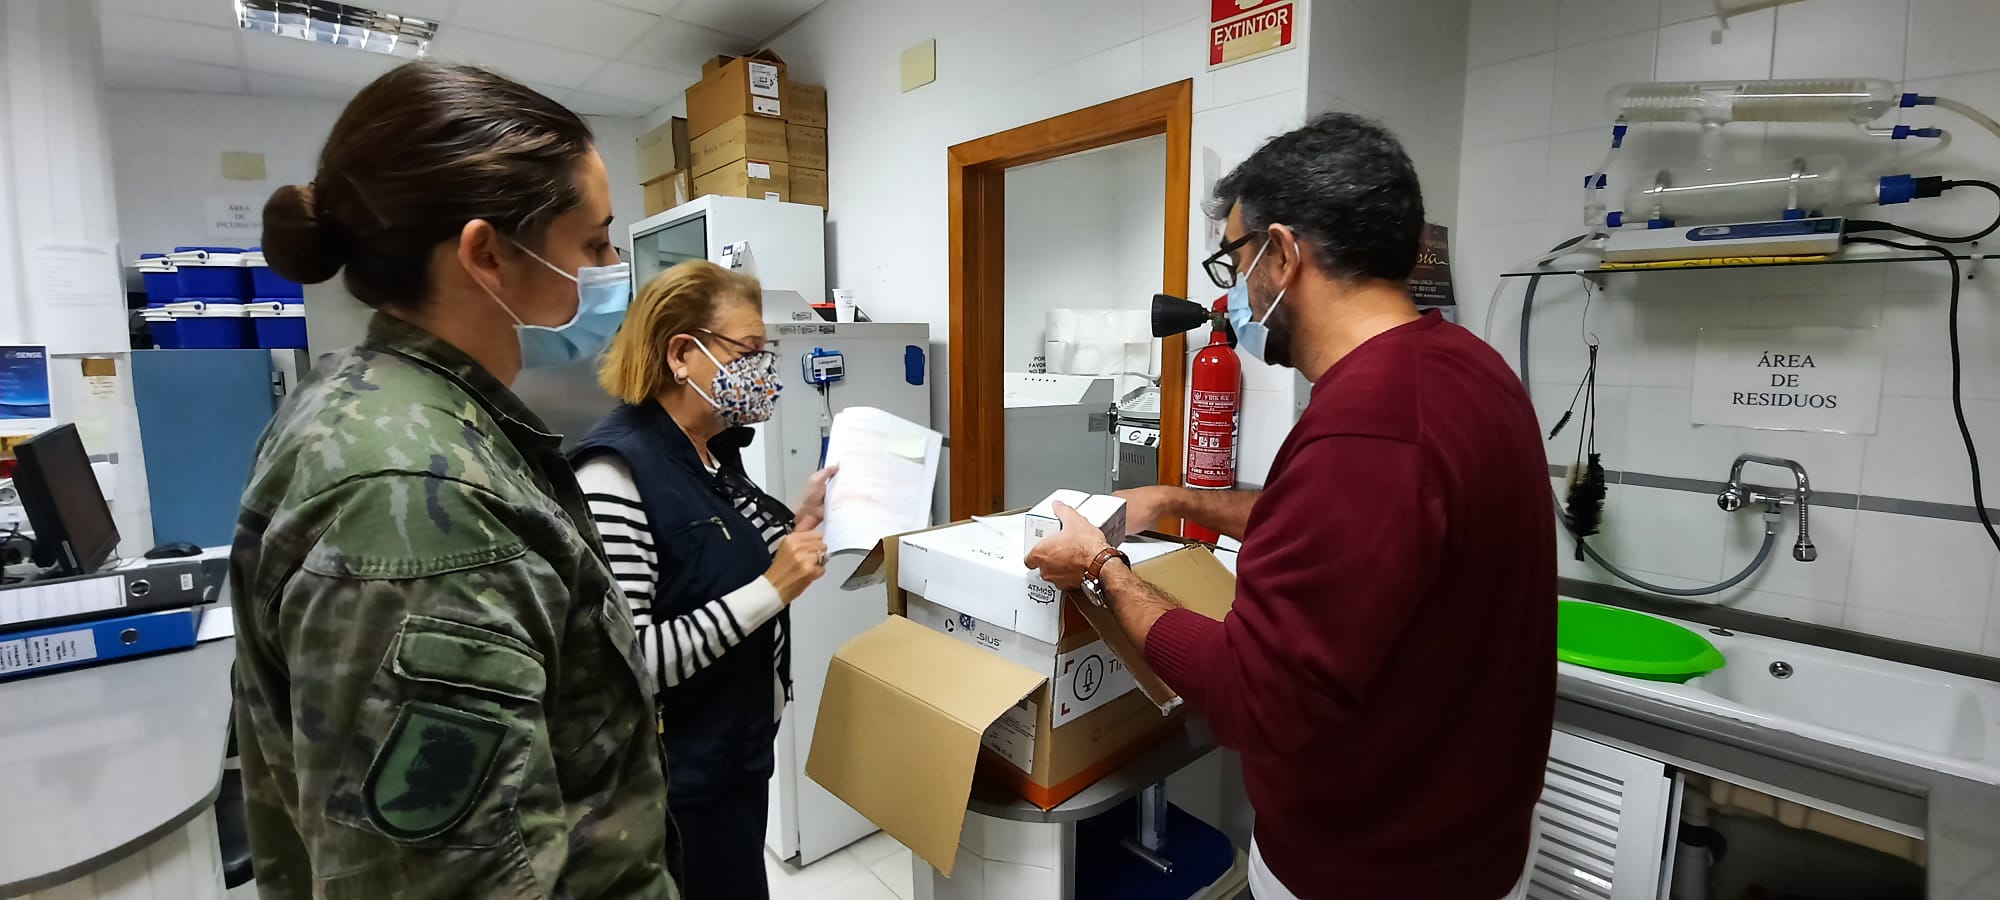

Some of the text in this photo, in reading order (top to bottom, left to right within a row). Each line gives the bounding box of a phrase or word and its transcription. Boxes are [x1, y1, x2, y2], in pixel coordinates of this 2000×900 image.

[1214, 8, 1288, 46] EXTINTOR
[1757, 350, 1816, 368] ÁREA
[1770, 373, 1800, 388] DE
[1732, 392, 1838, 409] RESIDUOS
[1027, 583, 1053, 596] ATMOS
